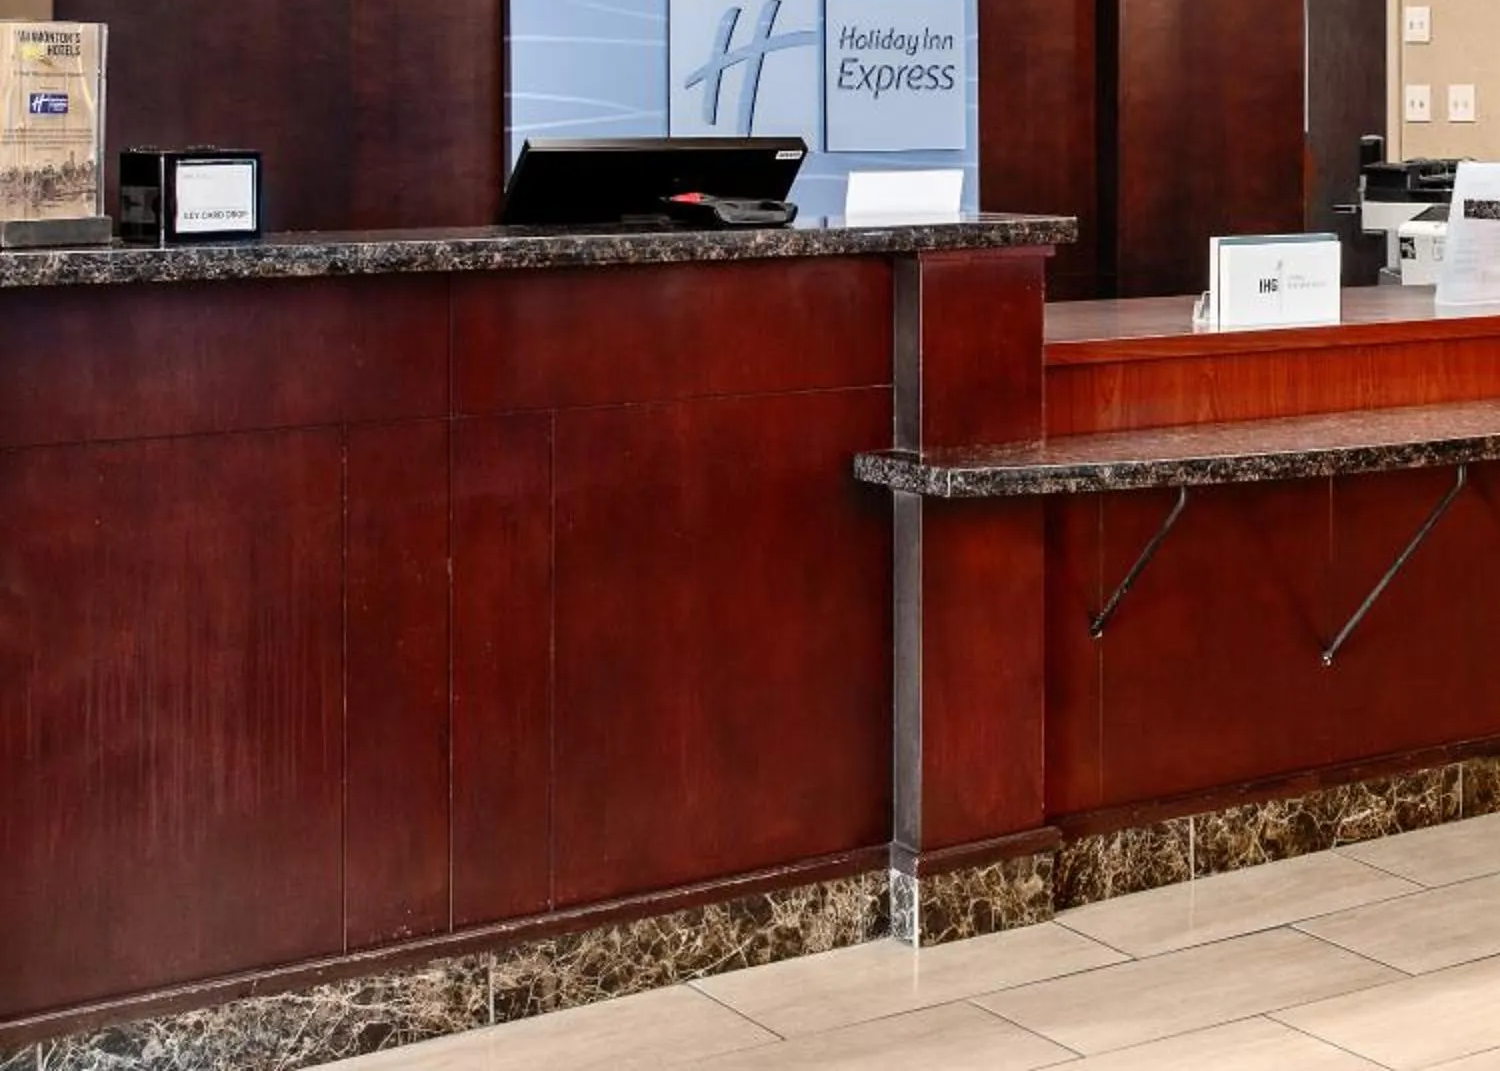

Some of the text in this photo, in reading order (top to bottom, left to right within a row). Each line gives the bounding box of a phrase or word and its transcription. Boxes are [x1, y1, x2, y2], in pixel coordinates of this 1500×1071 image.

[839, 26, 953, 56] Holiday Inn
[838, 57, 955, 99] Express
[1259, 278, 1279, 294] IHG
